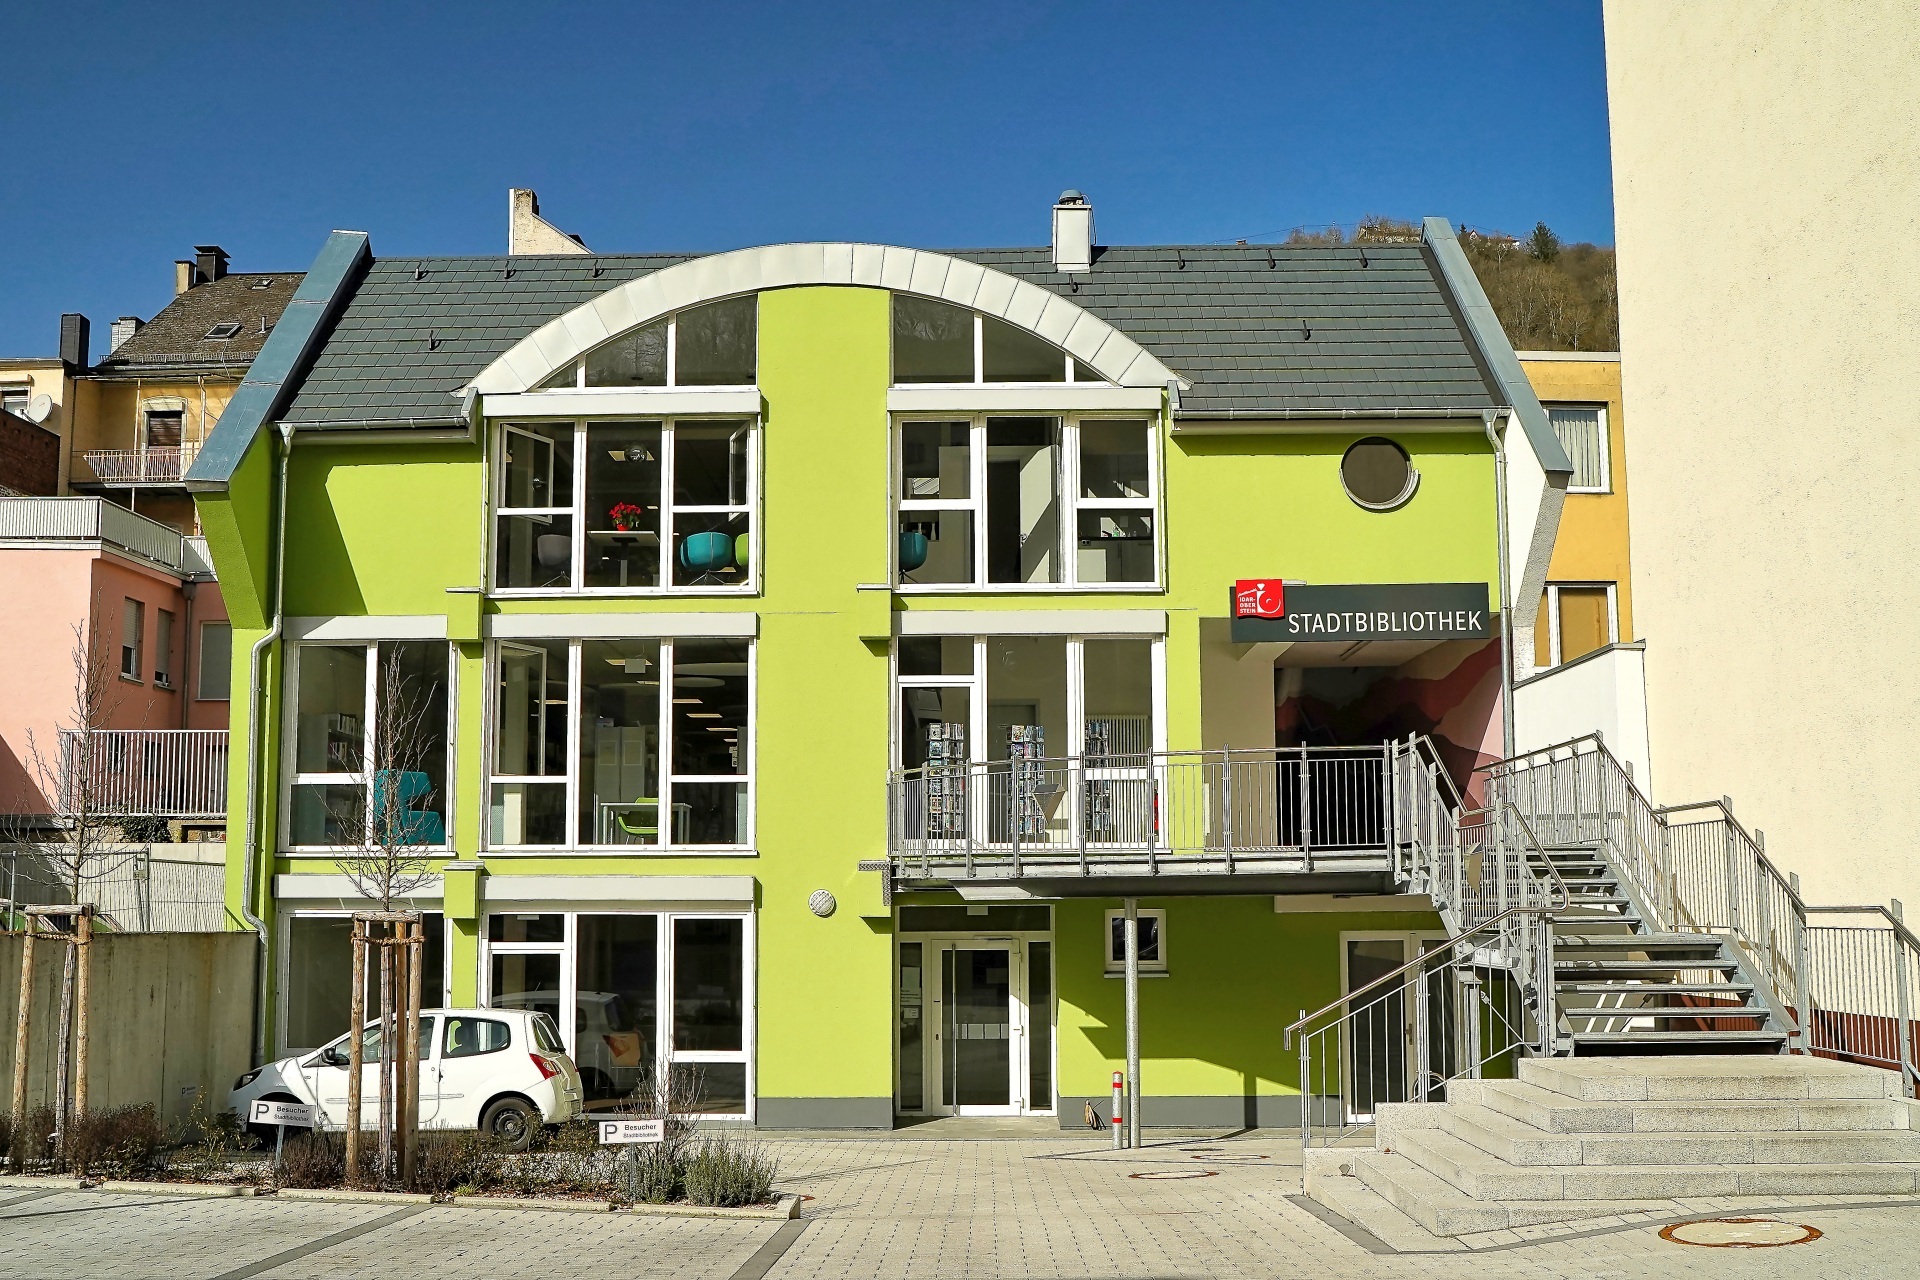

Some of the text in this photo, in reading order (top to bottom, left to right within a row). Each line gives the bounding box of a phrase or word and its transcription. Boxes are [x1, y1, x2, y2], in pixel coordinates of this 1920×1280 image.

[1288, 610, 1482, 634] STADTBIBLIOTHEK
[256, 1104, 269, 1120] P
[274, 1114, 309, 1122] Stadtbibliothek
[605, 1124, 617, 1141] P
